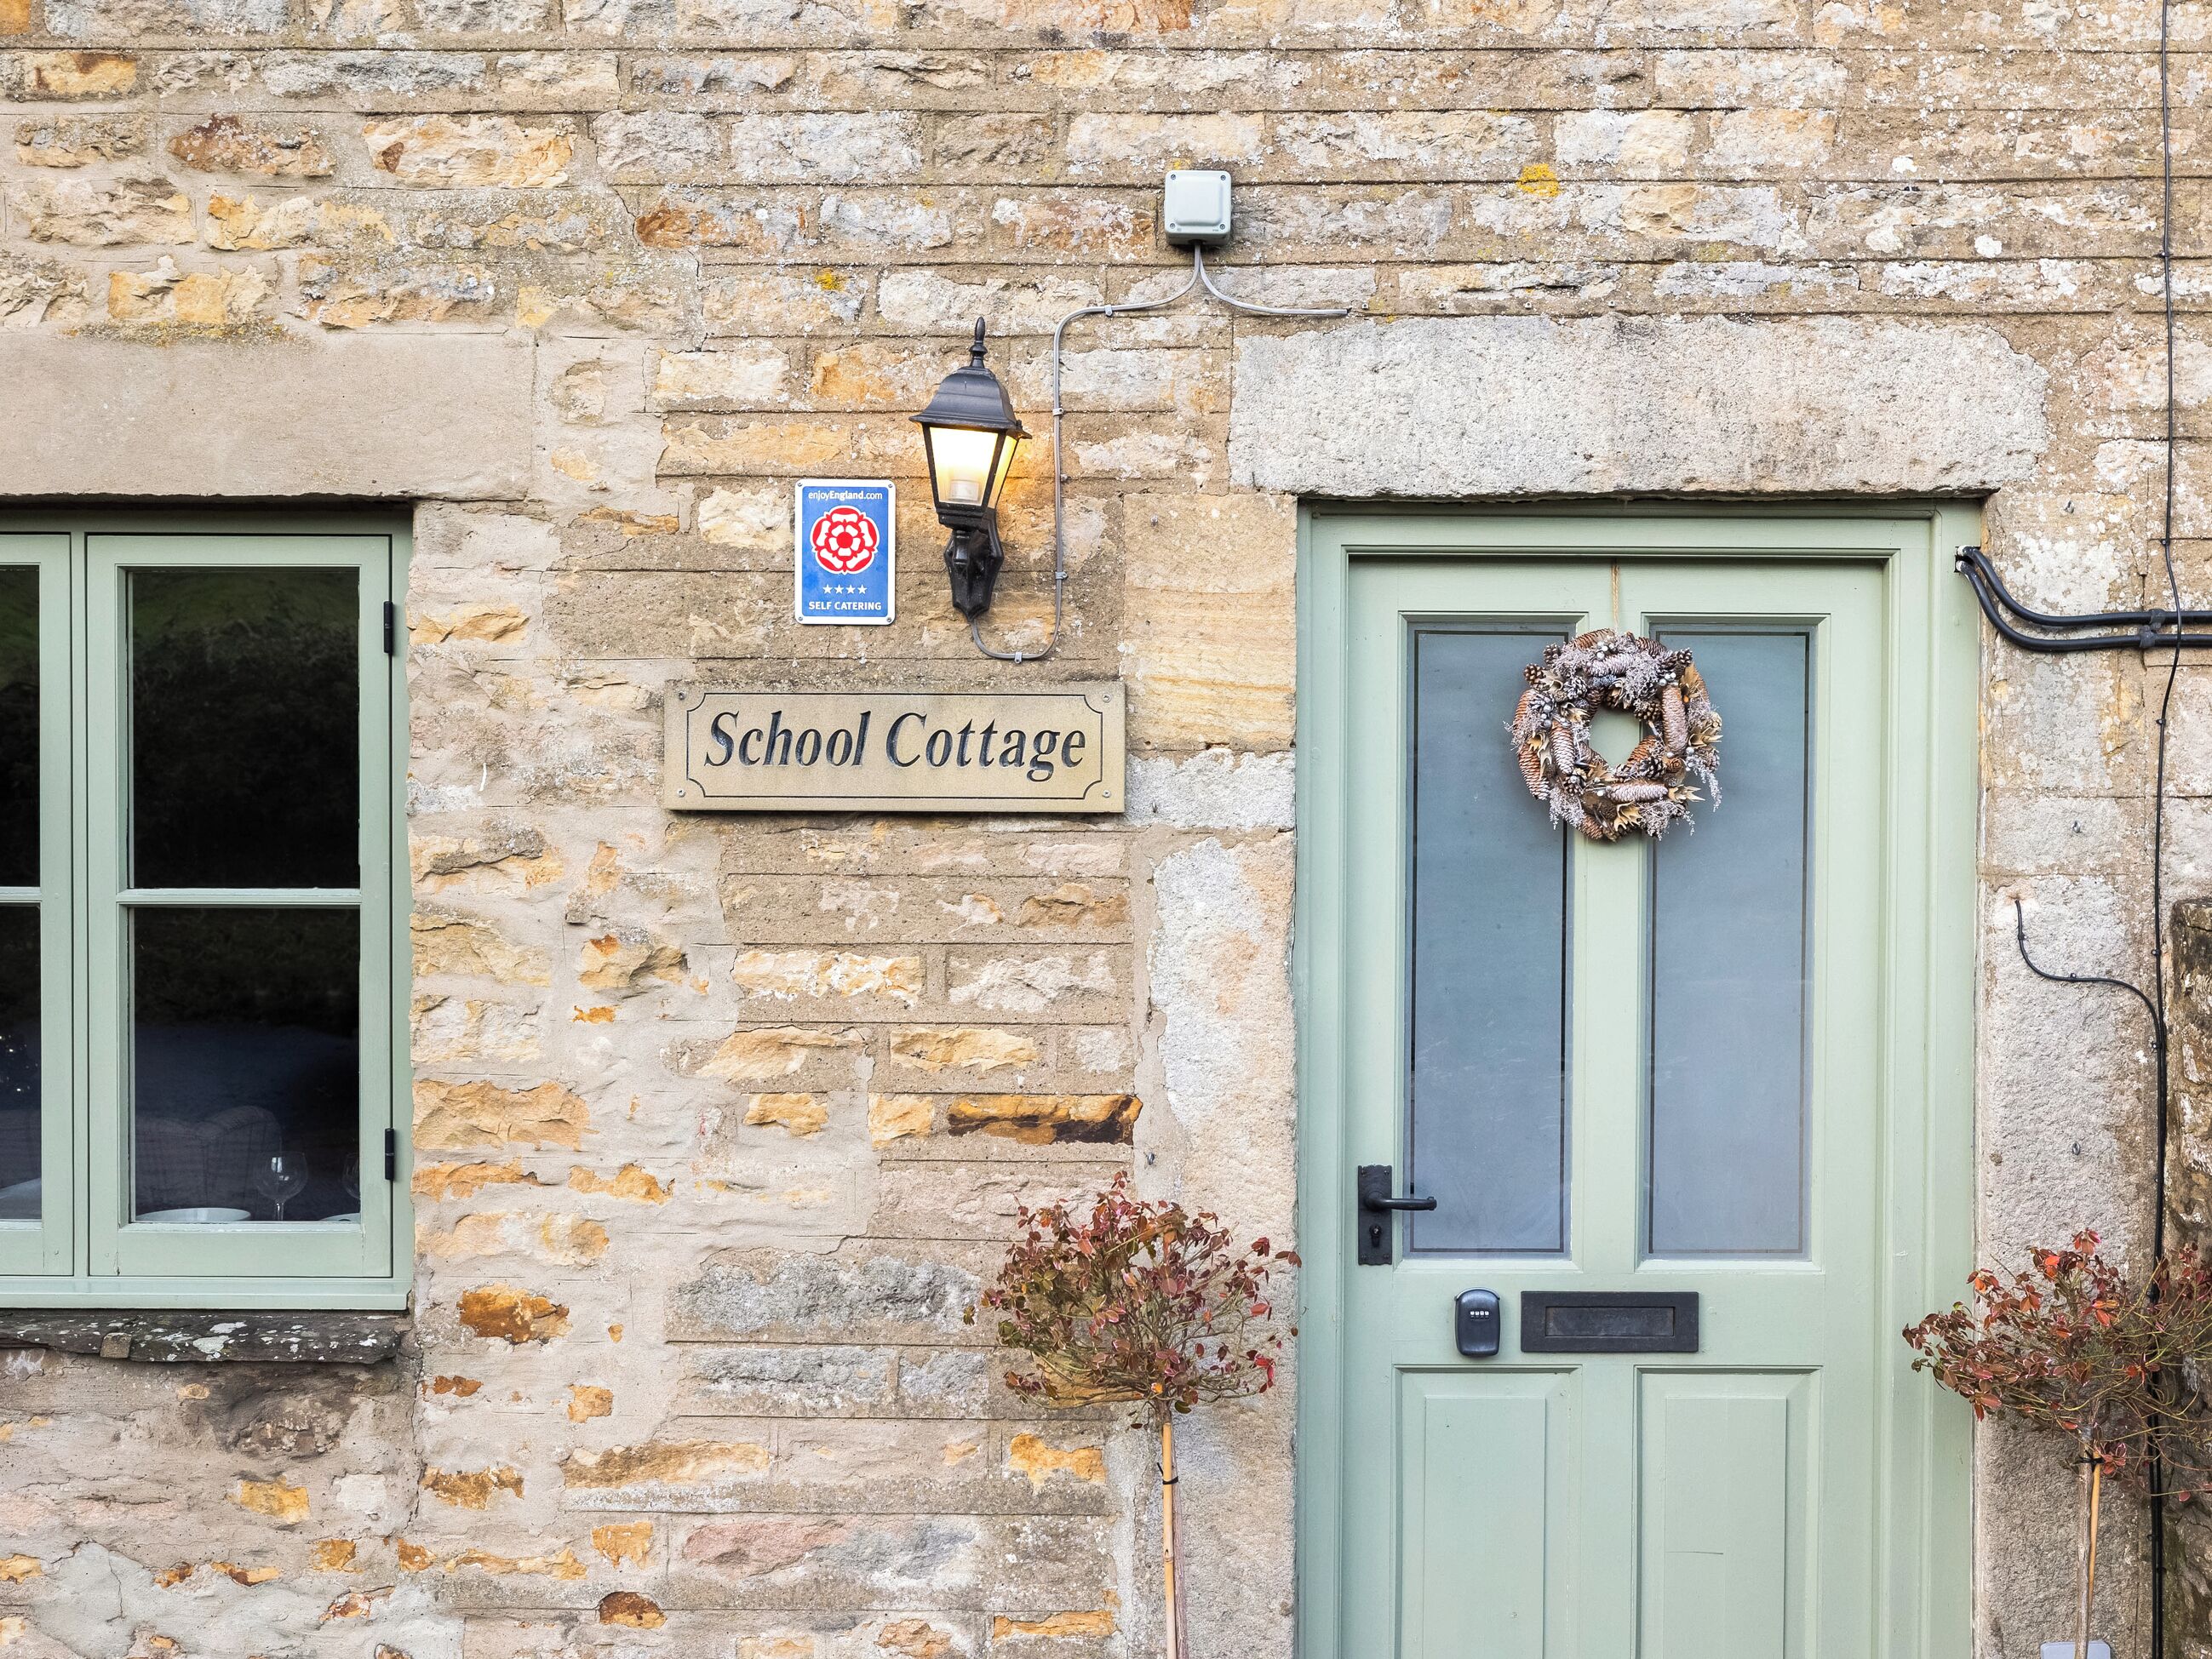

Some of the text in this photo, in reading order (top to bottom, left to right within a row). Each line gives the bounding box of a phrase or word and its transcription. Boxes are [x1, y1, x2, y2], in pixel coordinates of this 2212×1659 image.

[808, 490, 882, 501] enjoyEngland.com
[808, 601, 882, 610] SELF CATERING
[704, 710, 1086, 782] School Cottage
